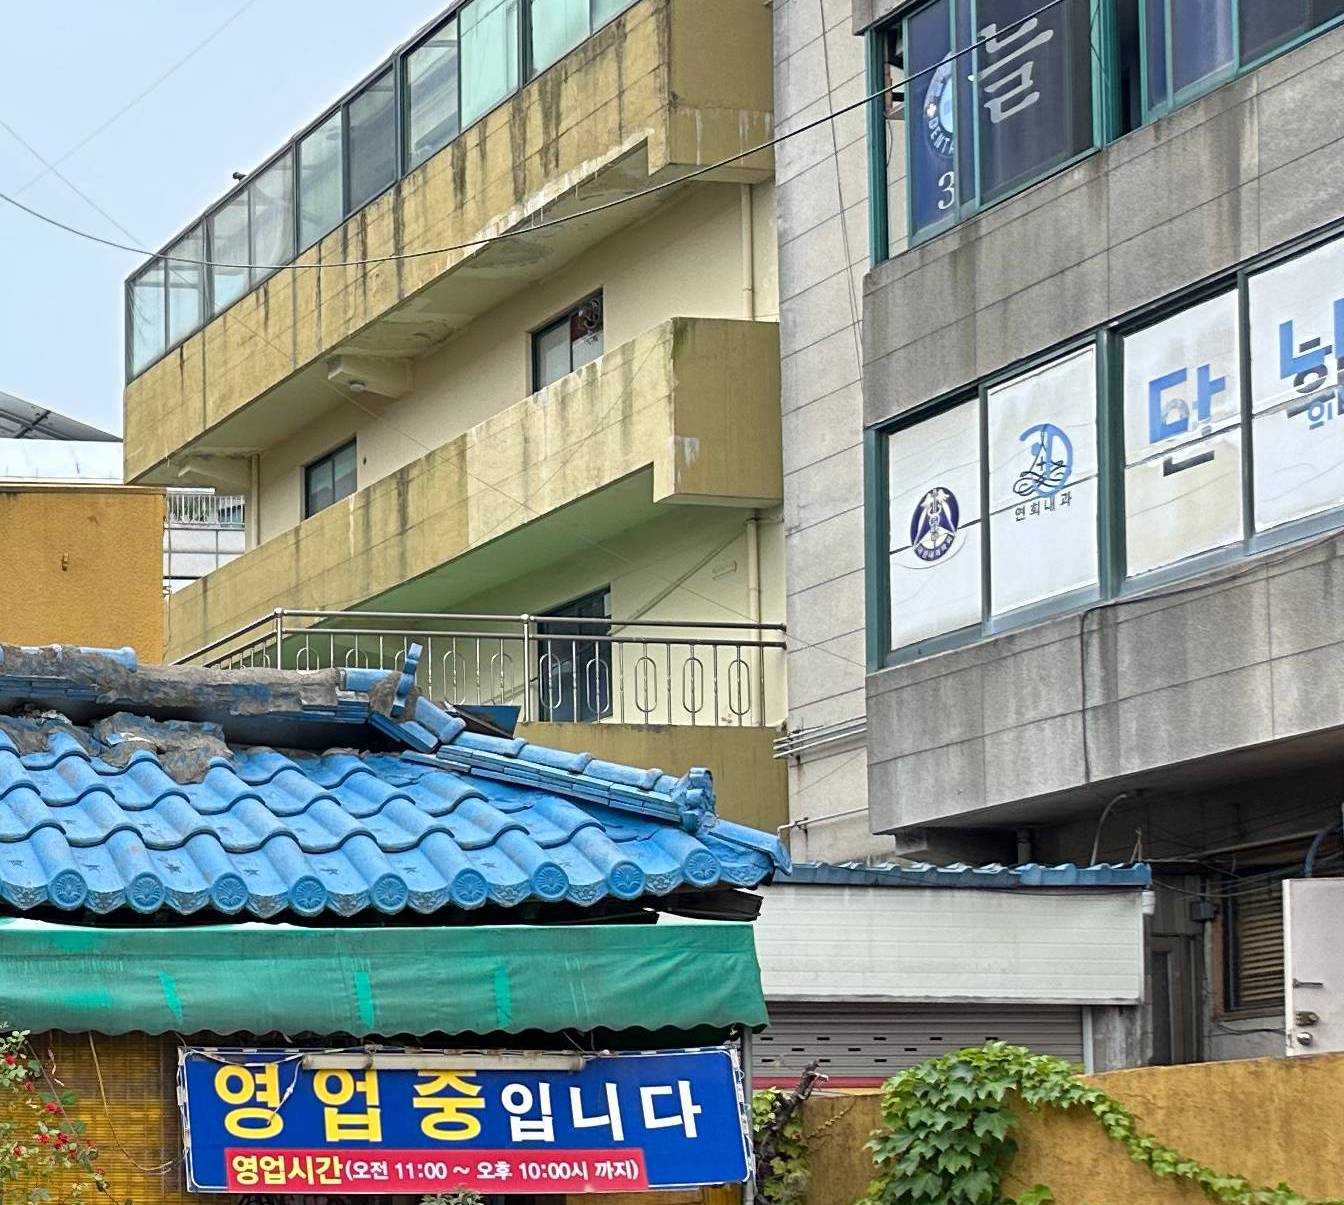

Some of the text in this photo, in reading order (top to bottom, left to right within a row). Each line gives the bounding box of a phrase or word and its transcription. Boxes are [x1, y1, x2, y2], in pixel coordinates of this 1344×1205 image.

[395, 1159, 447, 1182] 11:00
[476, 1159, 512, 1182] 오후
[518, 1159, 589, 1182] 10:00시
[594, 1158, 639, 1182] 까지)
